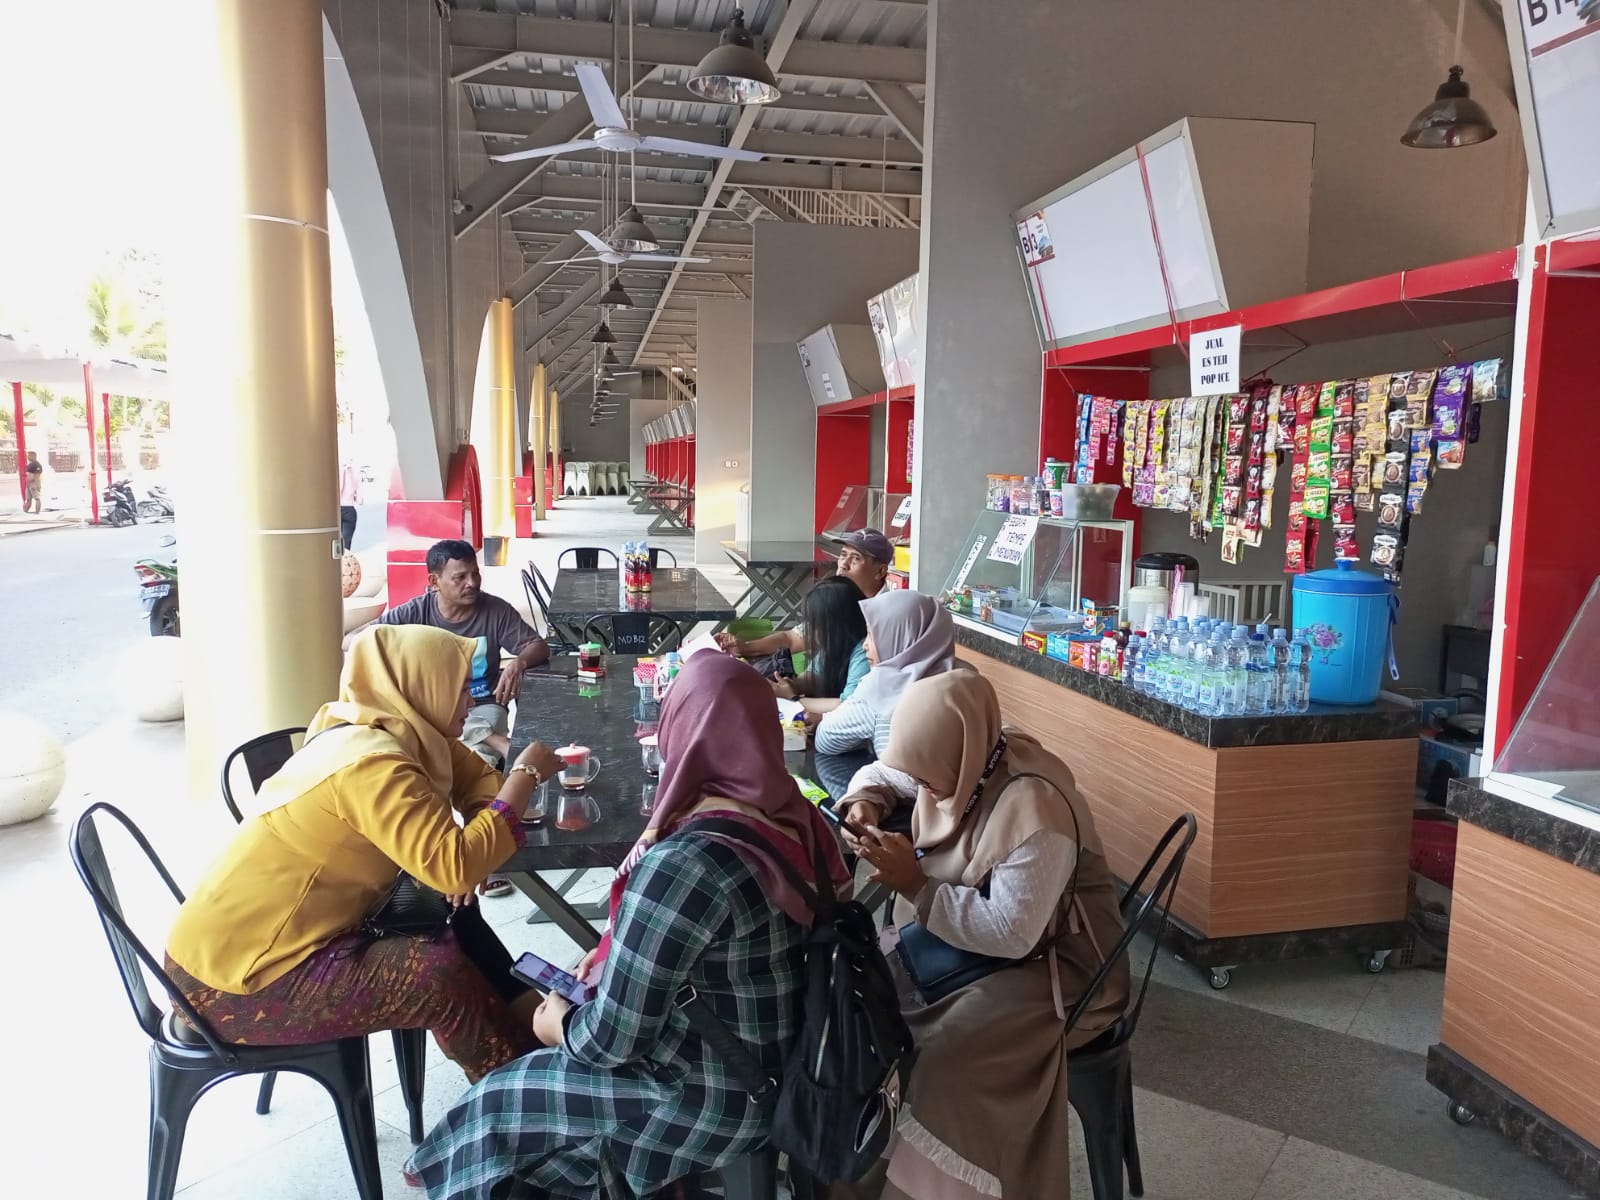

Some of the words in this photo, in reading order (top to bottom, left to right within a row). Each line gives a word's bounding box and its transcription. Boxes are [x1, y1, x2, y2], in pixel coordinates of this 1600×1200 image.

[1205, 337, 1224, 350] JUAL
[1202, 357, 1211, 368] ES
[1213, 354, 1228, 366] TEH
[1201, 374, 1216, 385] POP
[1218, 372, 1230, 383] ICE
